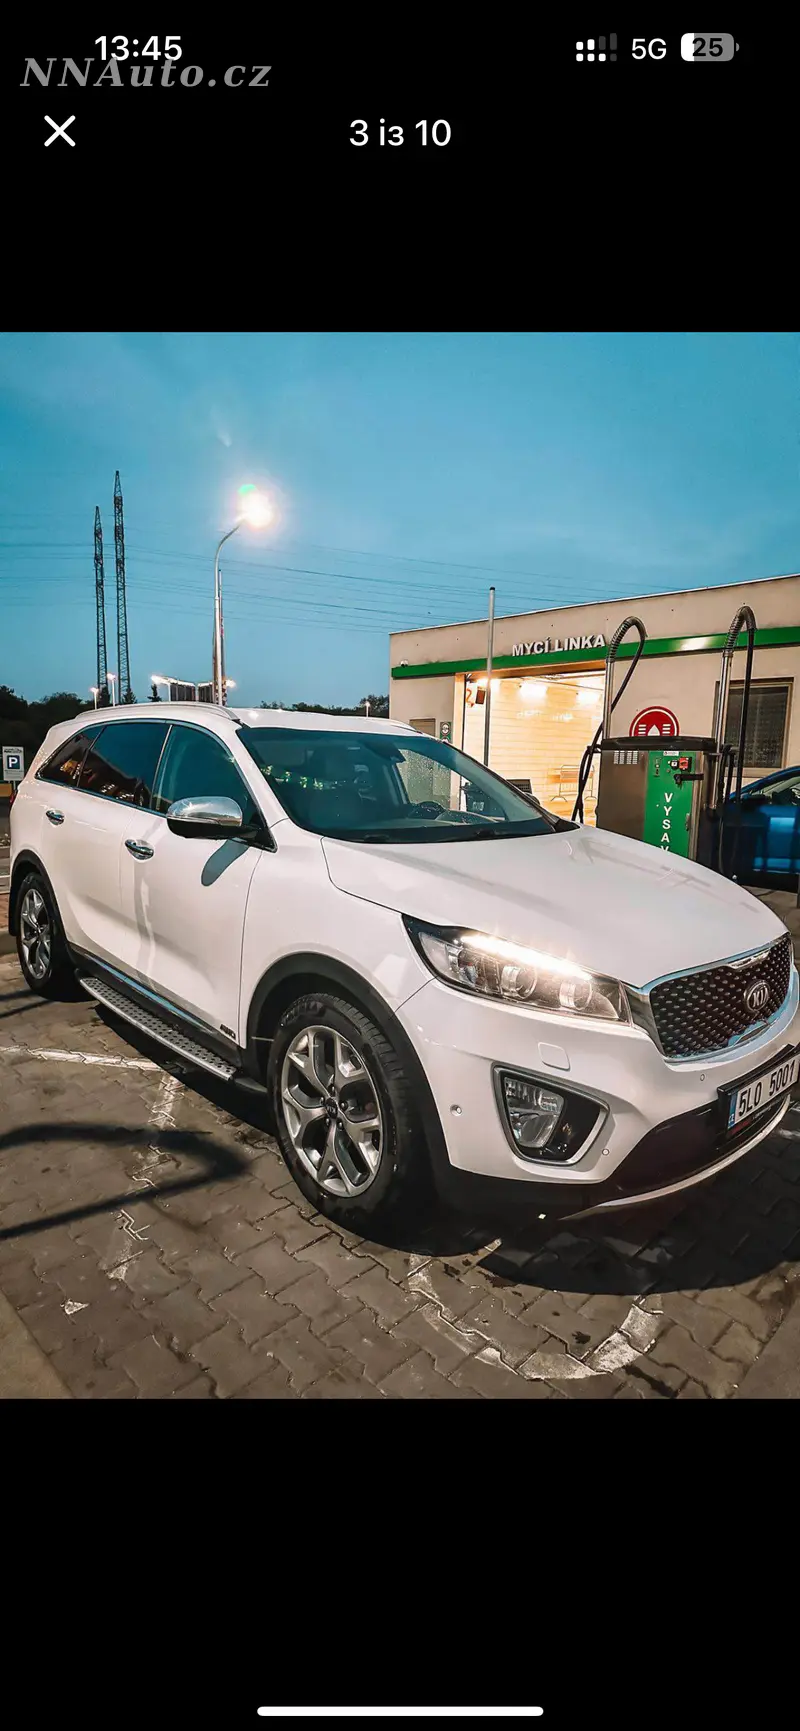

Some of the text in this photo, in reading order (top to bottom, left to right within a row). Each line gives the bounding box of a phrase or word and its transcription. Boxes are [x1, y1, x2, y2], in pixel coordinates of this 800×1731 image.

[512, 634, 606, 657] MYCÍ LINKA
[9, 757, 18, 768] P
[769, 1059, 796, 1097] 5001
